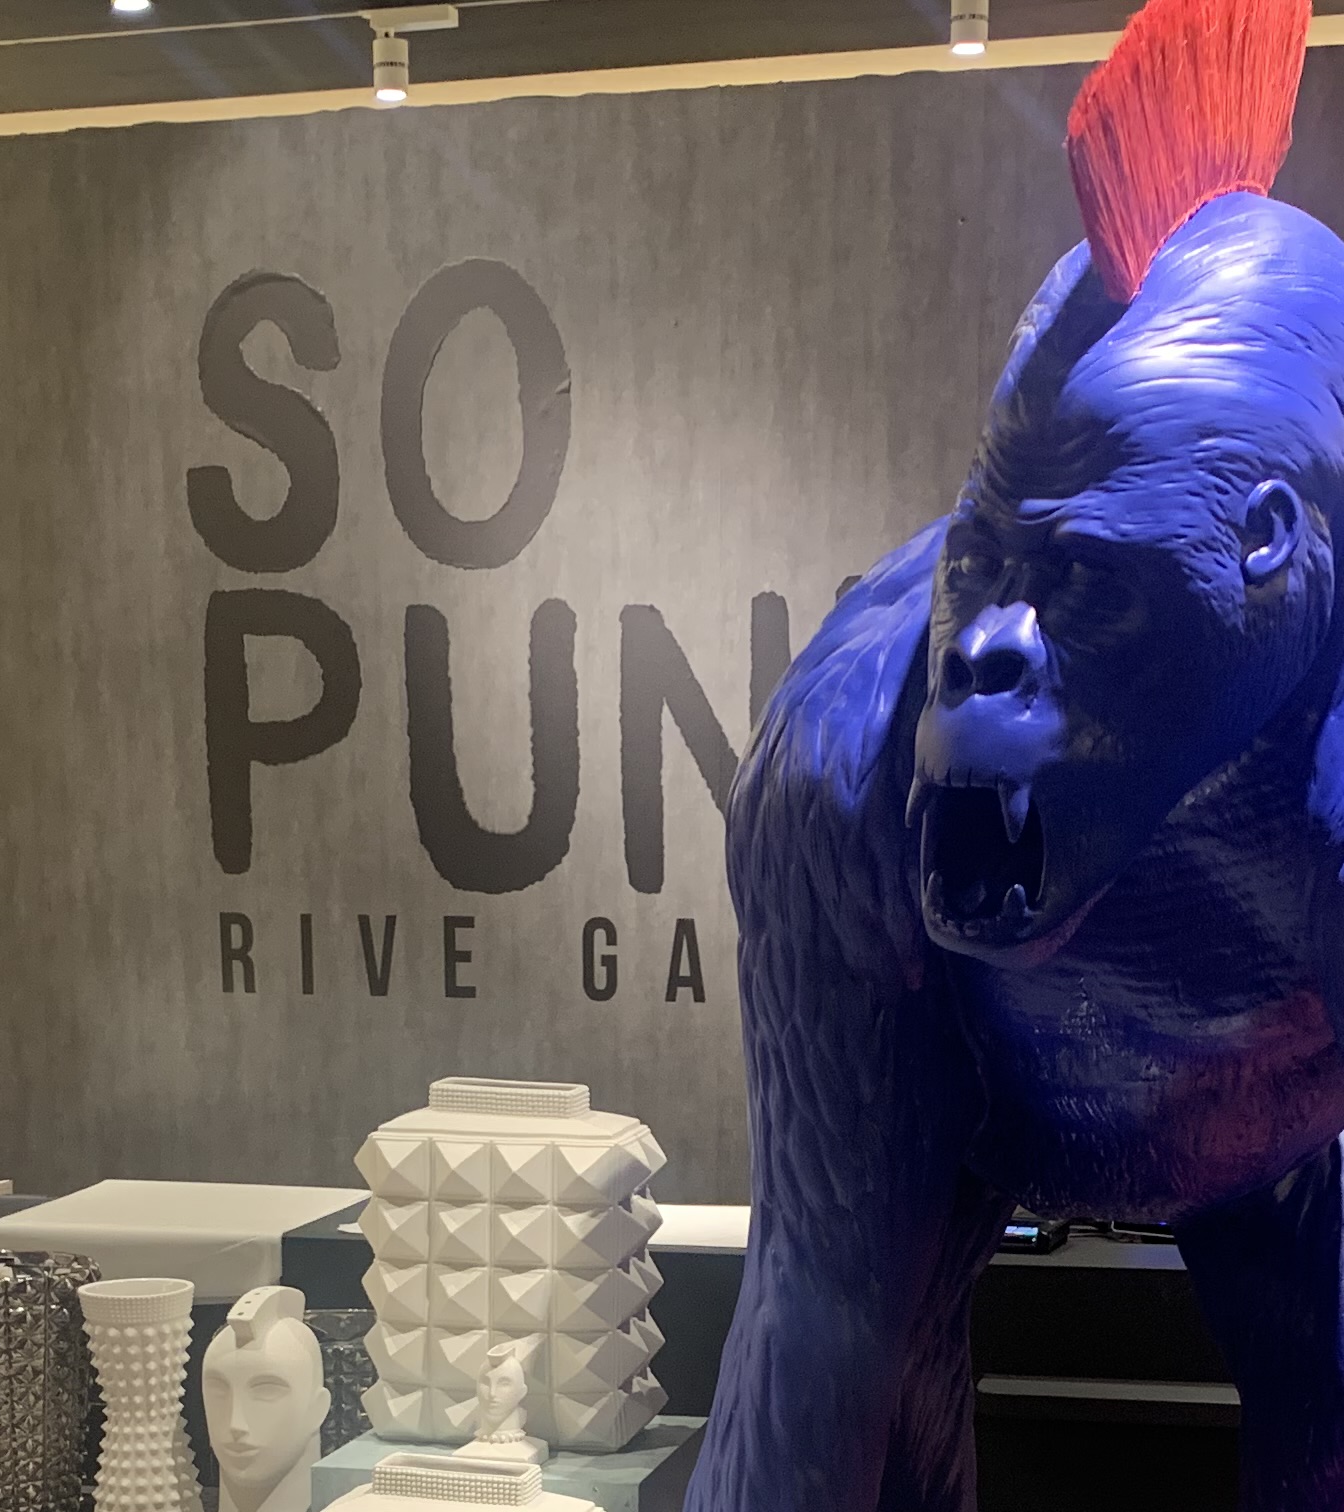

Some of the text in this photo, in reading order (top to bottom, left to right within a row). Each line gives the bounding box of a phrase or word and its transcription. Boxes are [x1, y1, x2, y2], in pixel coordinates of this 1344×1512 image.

[186, 256, 572, 574] SO
[203, 575, 862, 895] PUN
[218, 911, 478, 999] RIVE
